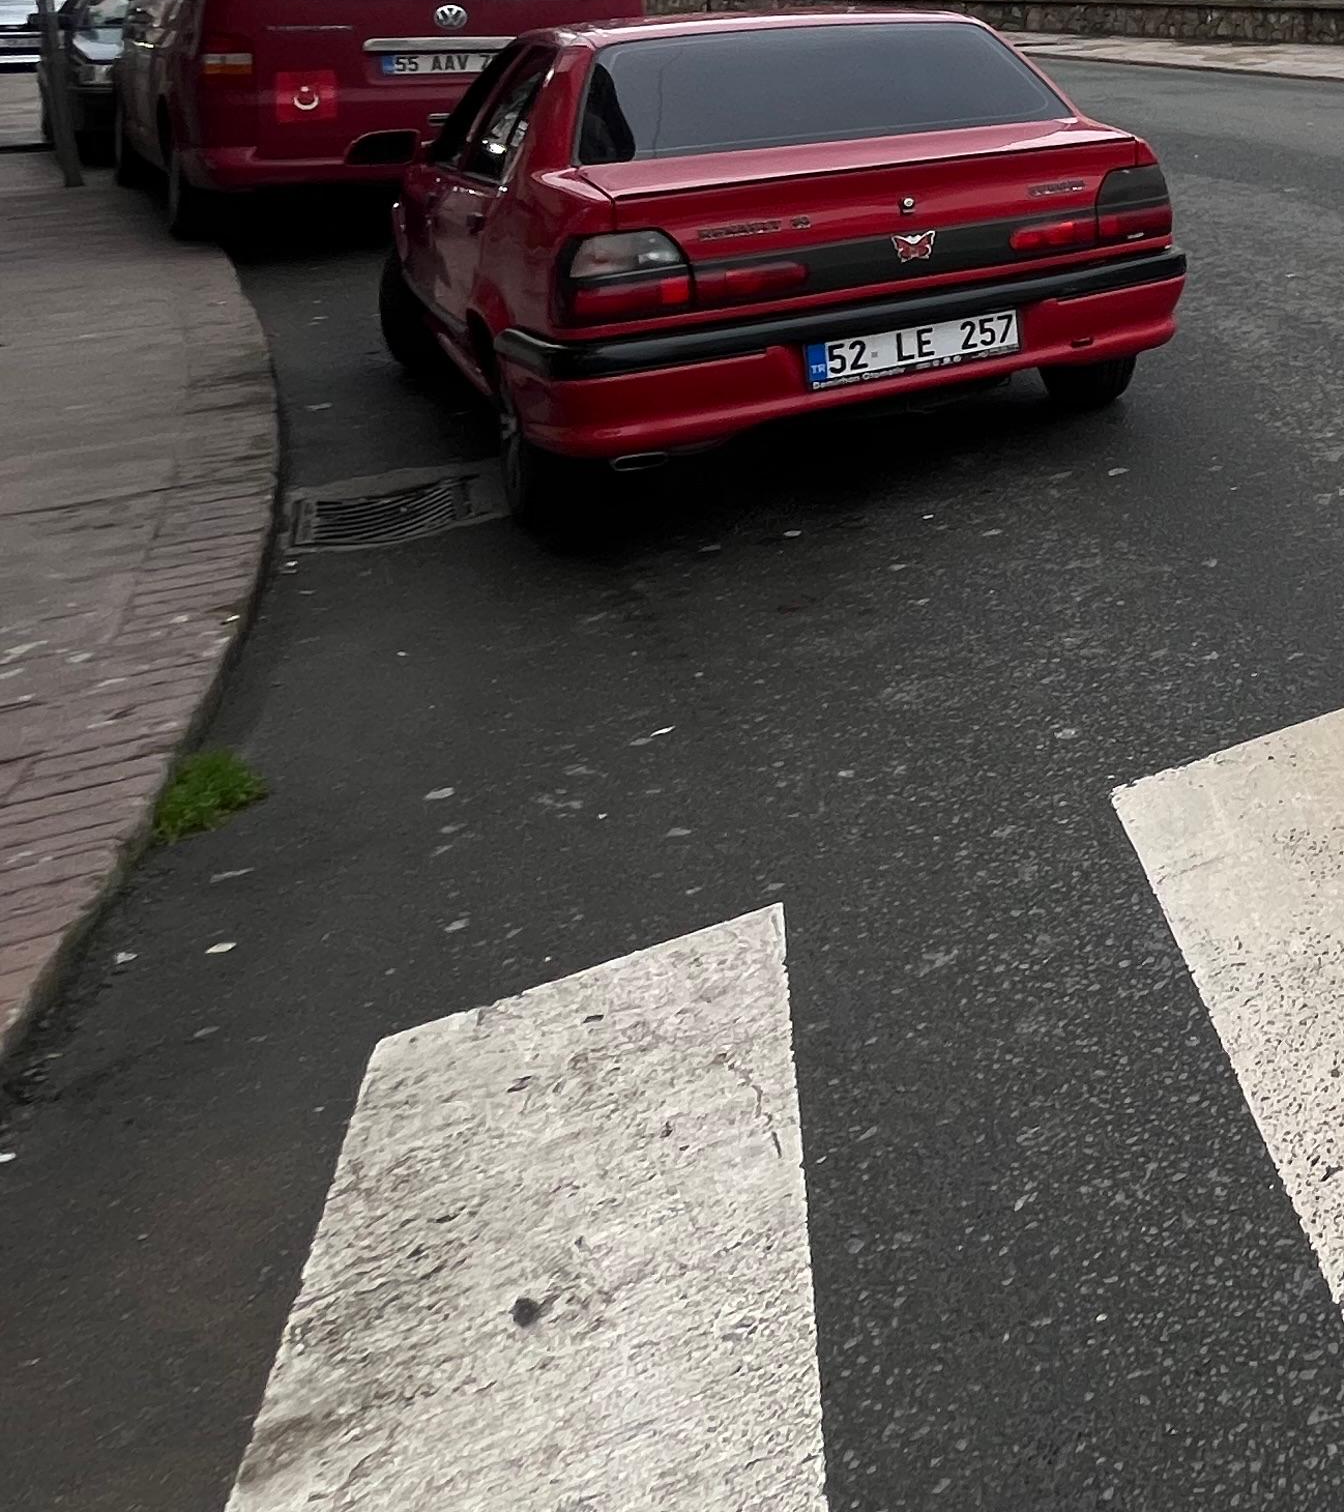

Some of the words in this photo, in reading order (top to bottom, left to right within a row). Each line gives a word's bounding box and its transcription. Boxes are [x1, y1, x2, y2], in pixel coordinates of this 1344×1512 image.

[394, 56, 419, 72] 55
[430, 55, 469, 72] AAV
[828, 340, 868, 374] 52
[896, 328, 935, 362] LE
[960, 314, 1014, 350] 257
[811, 363, 826, 374] TR
